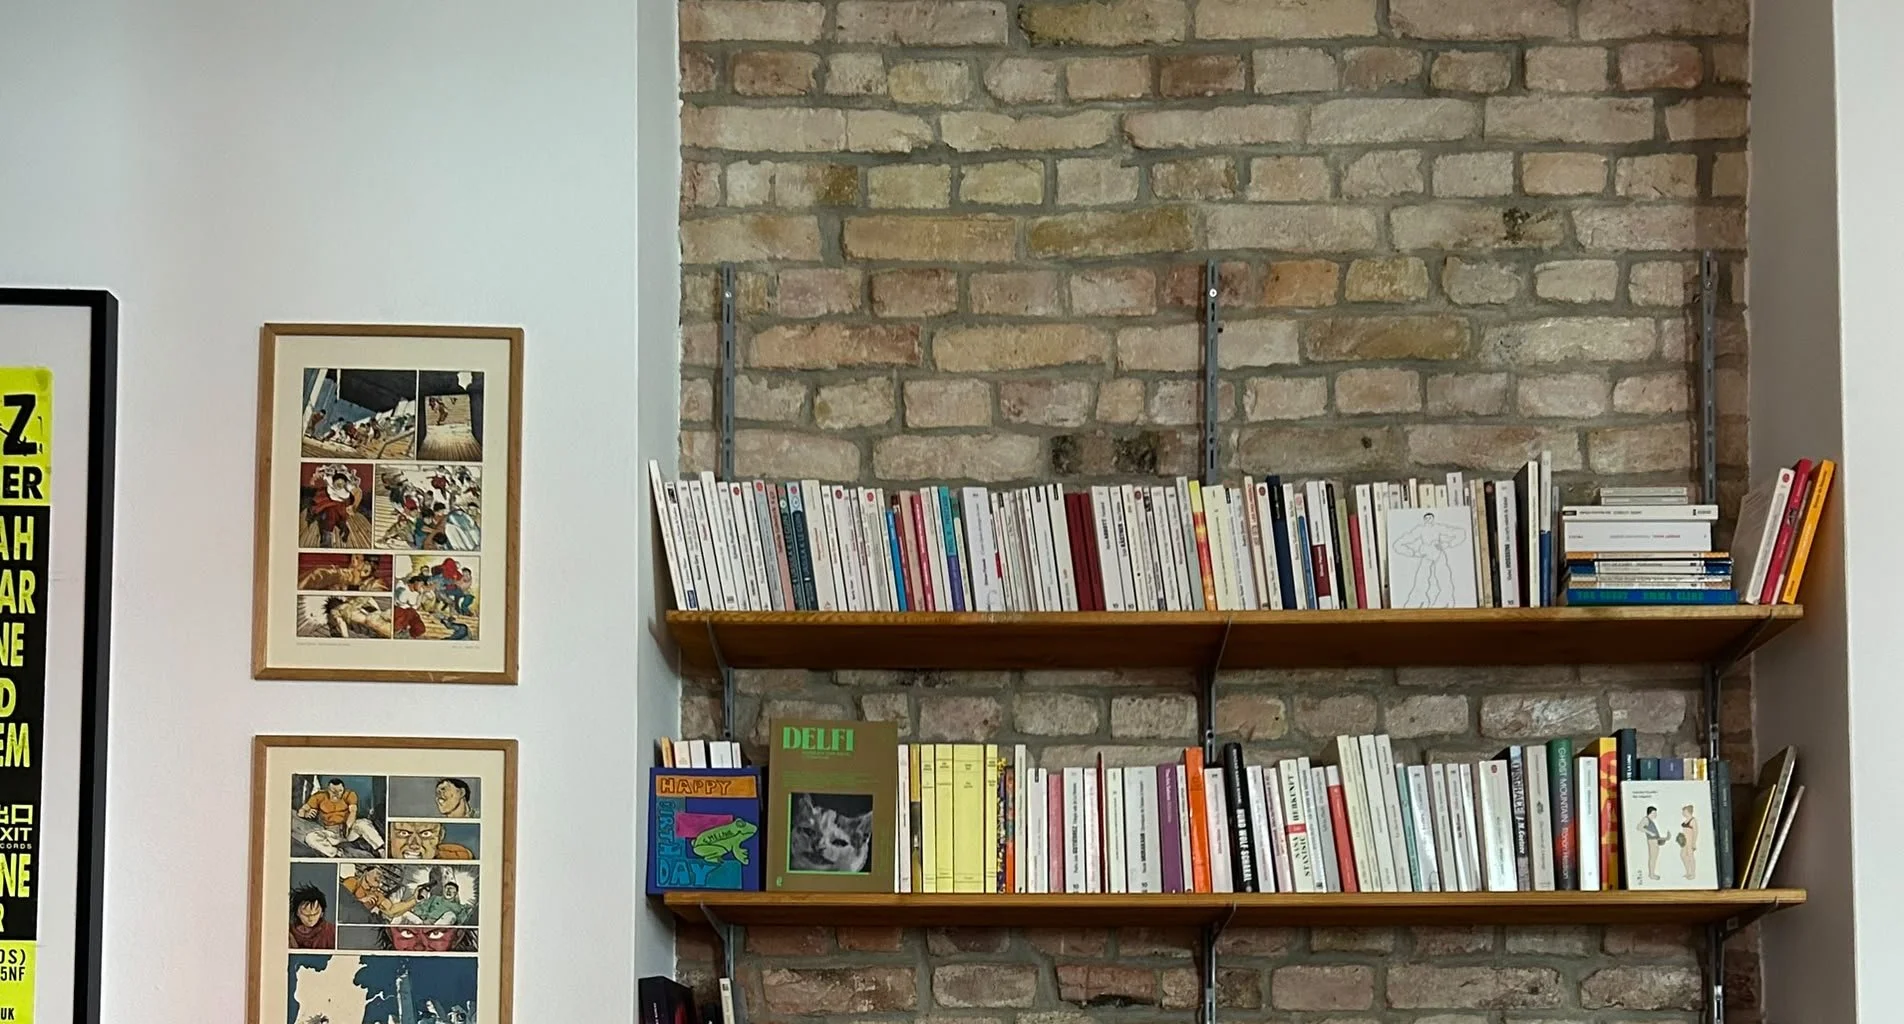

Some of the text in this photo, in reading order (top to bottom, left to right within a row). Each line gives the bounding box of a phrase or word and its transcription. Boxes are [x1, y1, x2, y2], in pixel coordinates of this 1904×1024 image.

[2, 466, 43, 499] ER
[0, 569, 36, 614] AR
[783, 727, 854, 751] DELFI
[1558, 747, 1568, 777] GHOST
[660, 778, 731, 794] HAPPY
[1560, 778, 1569, 823] MOUNTAIN
[1239, 830, 1249, 849] WOLF
[658, 862, 718, 886] DAY
